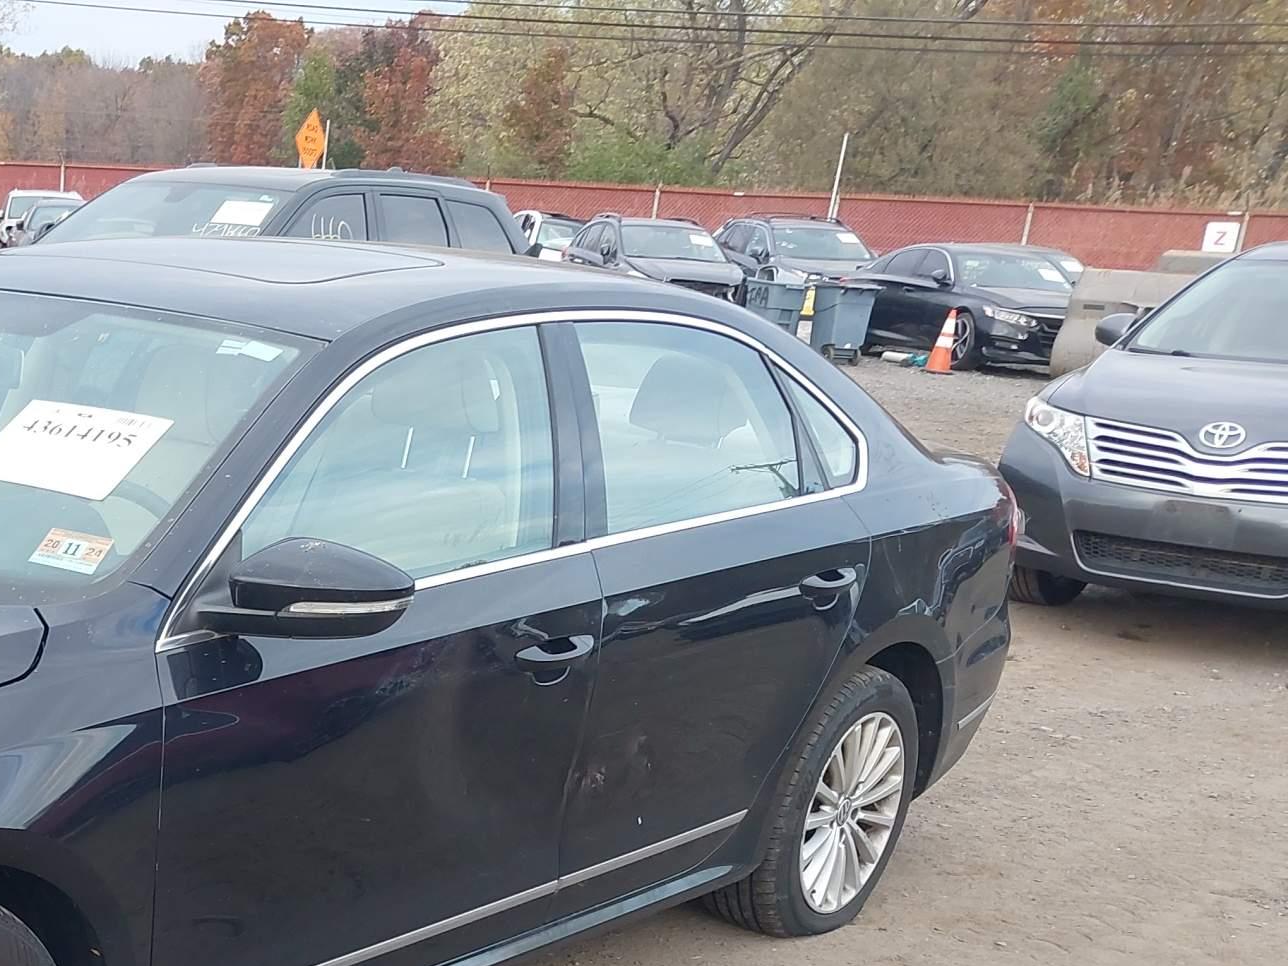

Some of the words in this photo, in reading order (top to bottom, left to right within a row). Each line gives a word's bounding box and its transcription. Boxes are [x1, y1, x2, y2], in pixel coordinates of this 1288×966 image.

[1213, 231, 1228, 246] Z
[23, 419, 138, 448] 43614195
[44, 539, 60, 549] 20
[62, 542, 81, 556] 11
